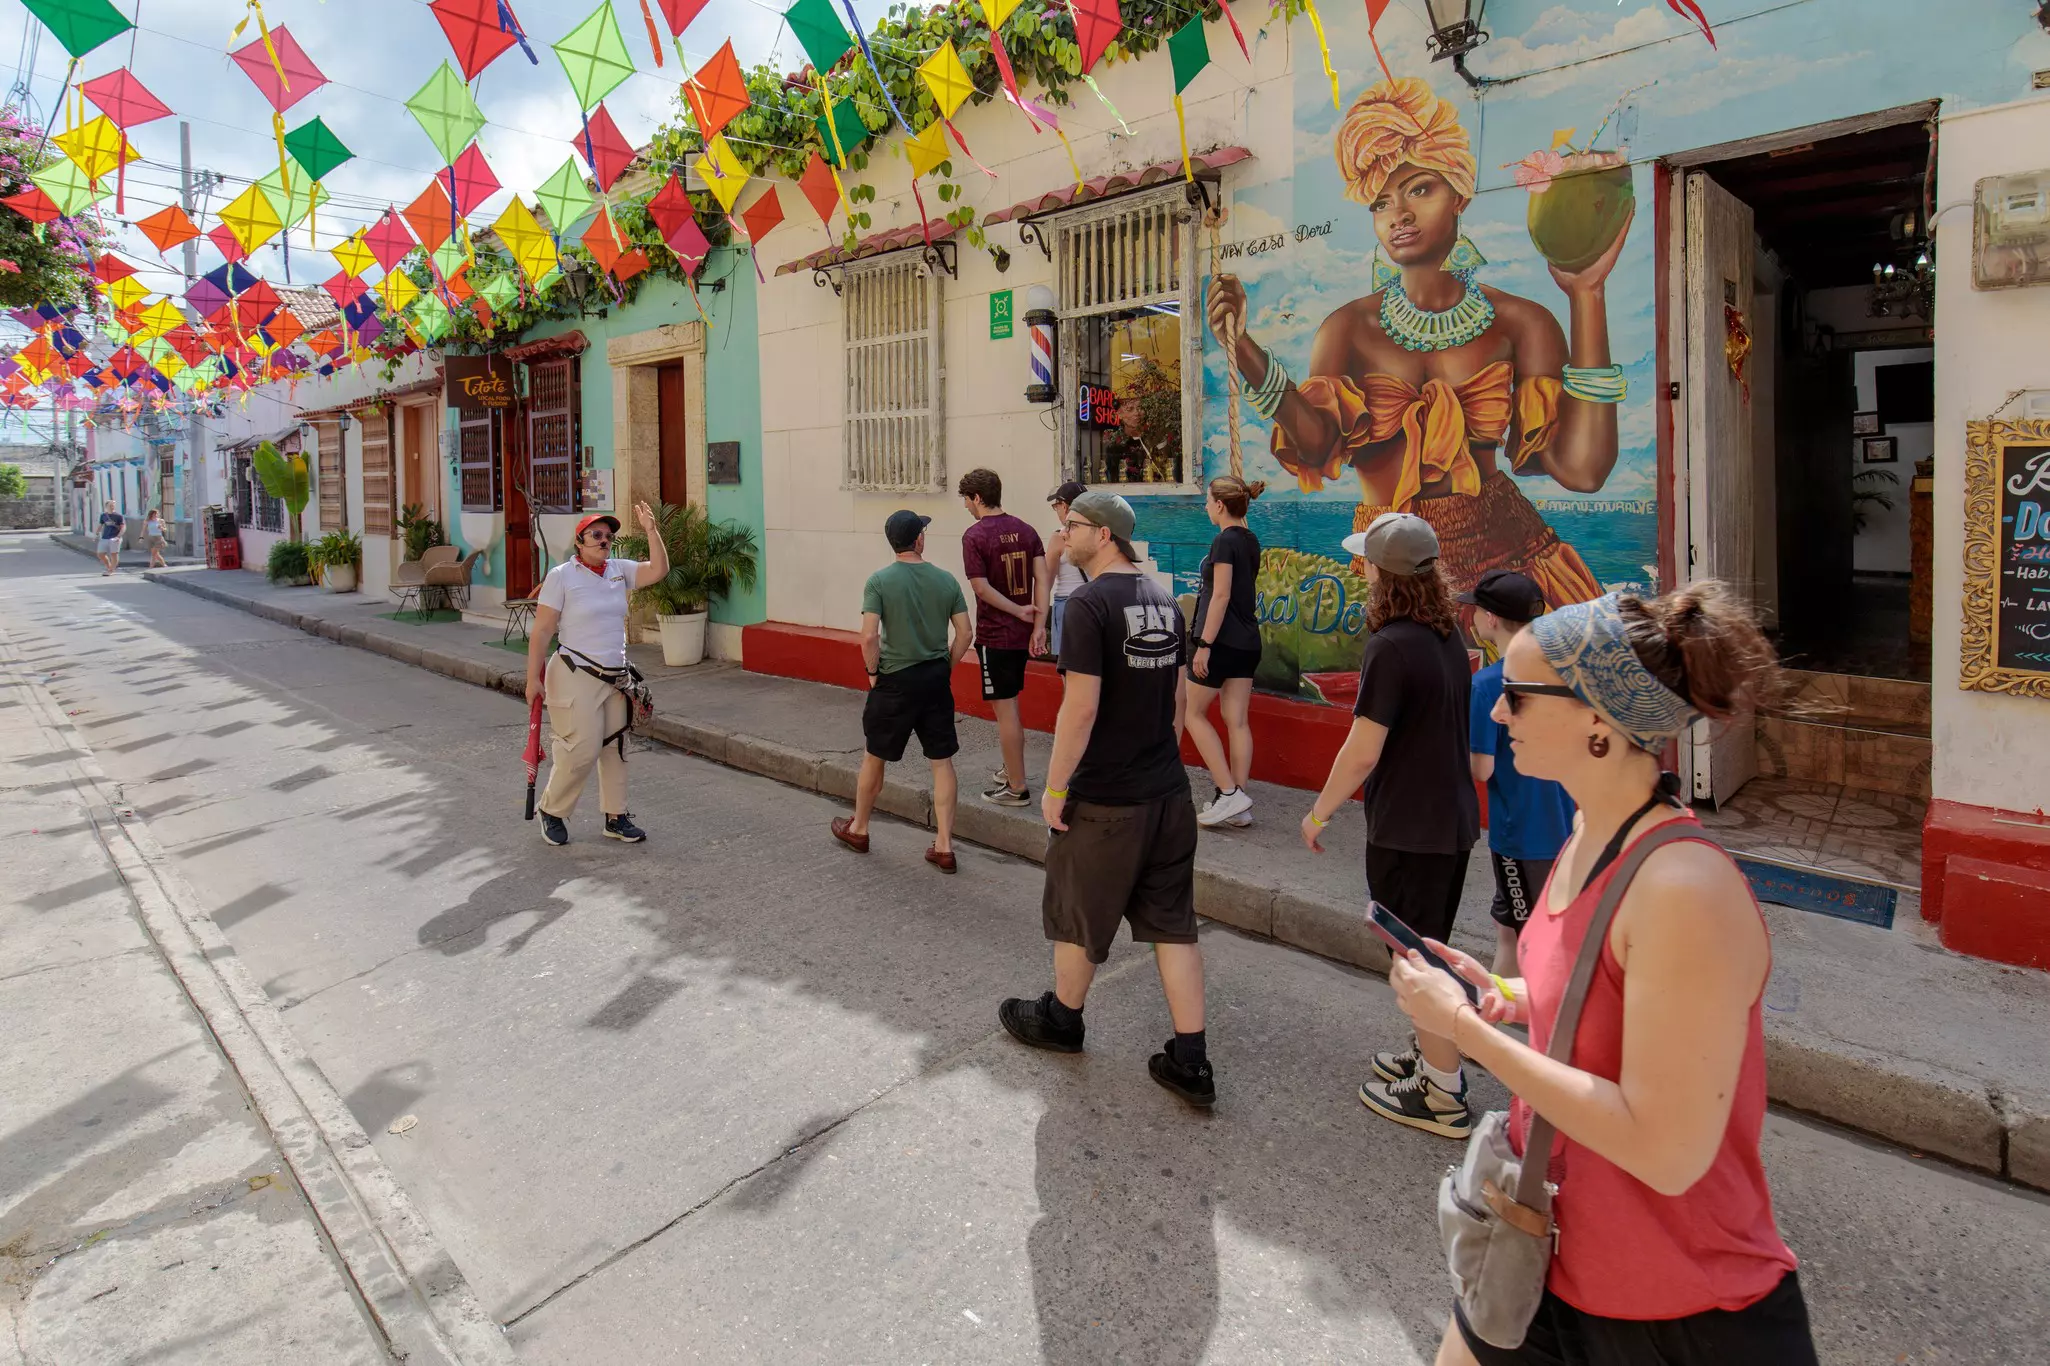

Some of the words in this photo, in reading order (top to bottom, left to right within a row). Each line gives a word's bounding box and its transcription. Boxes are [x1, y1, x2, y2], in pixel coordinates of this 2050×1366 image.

[1247, 234, 1285, 257] Casa
[999, 532, 1019, 544] BENY
[1000, 550, 1028, 596] 10
[1254, 591, 1299, 626] sa
[1299, 565, 1367, 636] Do
[1501, 855, 1530, 922] Reebok
